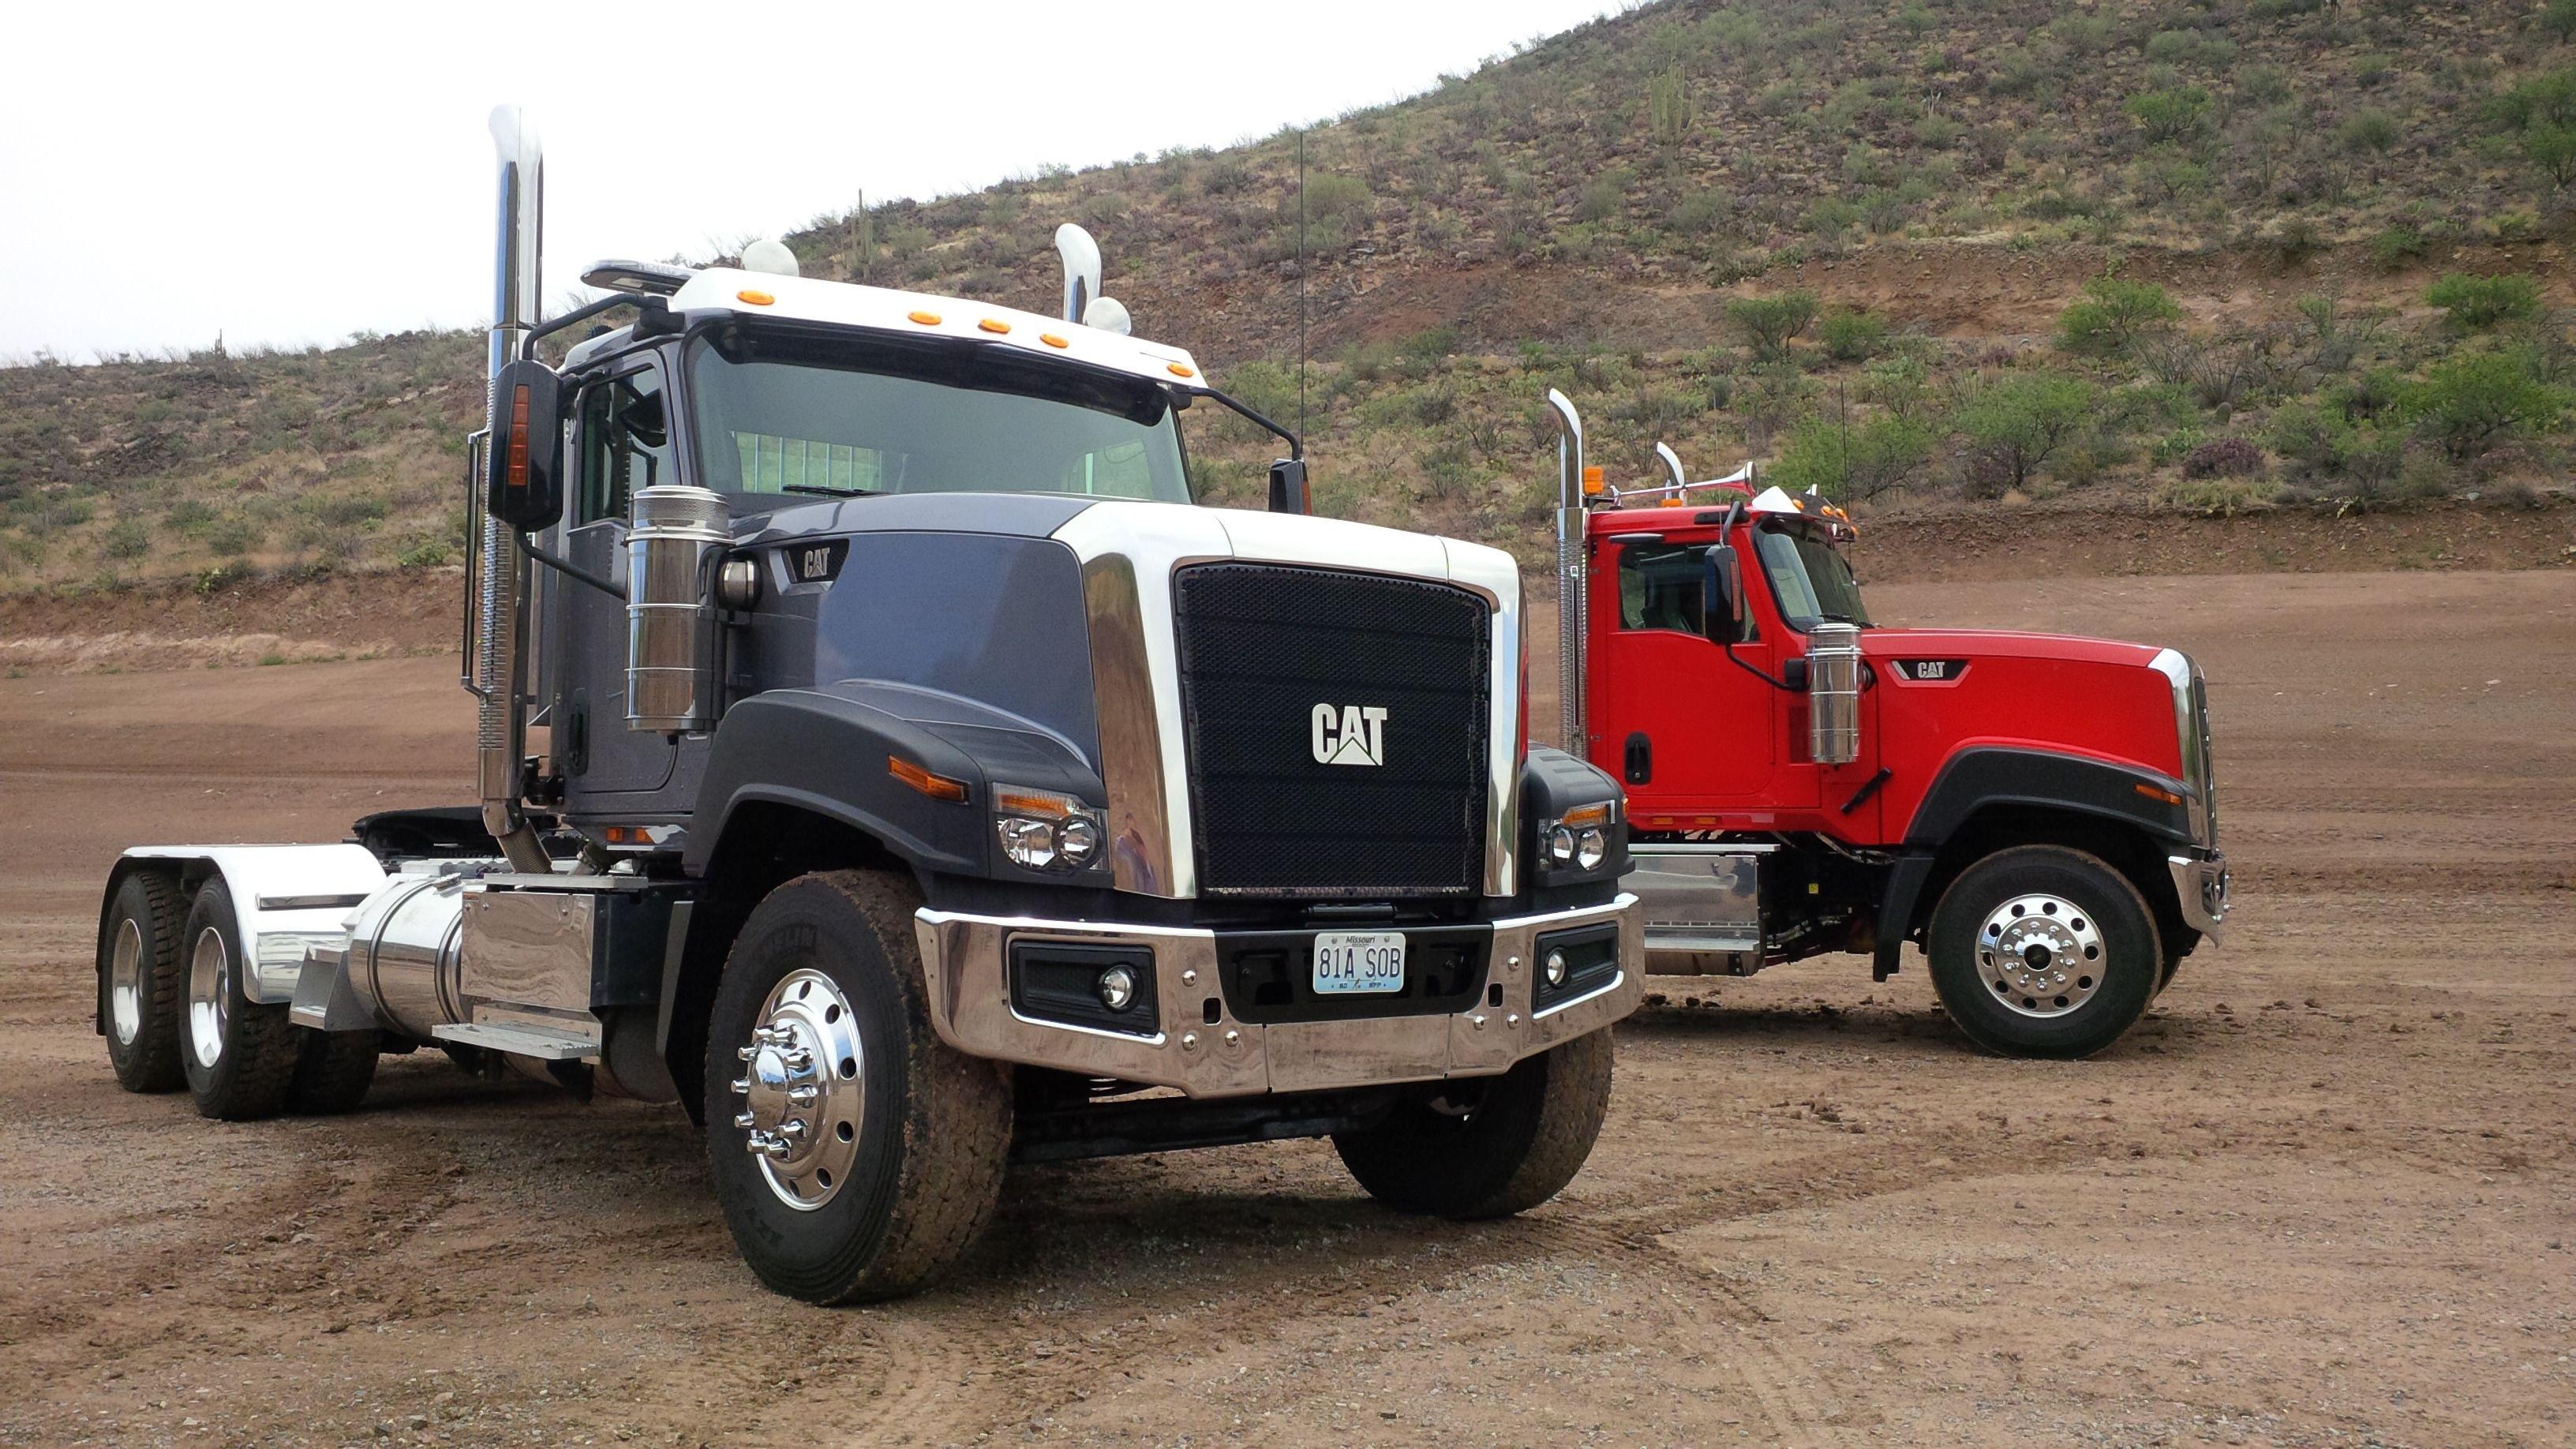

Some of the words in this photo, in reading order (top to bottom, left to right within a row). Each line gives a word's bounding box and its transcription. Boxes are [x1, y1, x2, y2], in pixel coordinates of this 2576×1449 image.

[804, 547, 829, 578] CAT
[1918, 661, 1945, 678] CAT
[1312, 703, 1387, 766] CAT
[1346, 935, 1376, 944] Missouri
[1320, 948, 1354, 979] 81A
